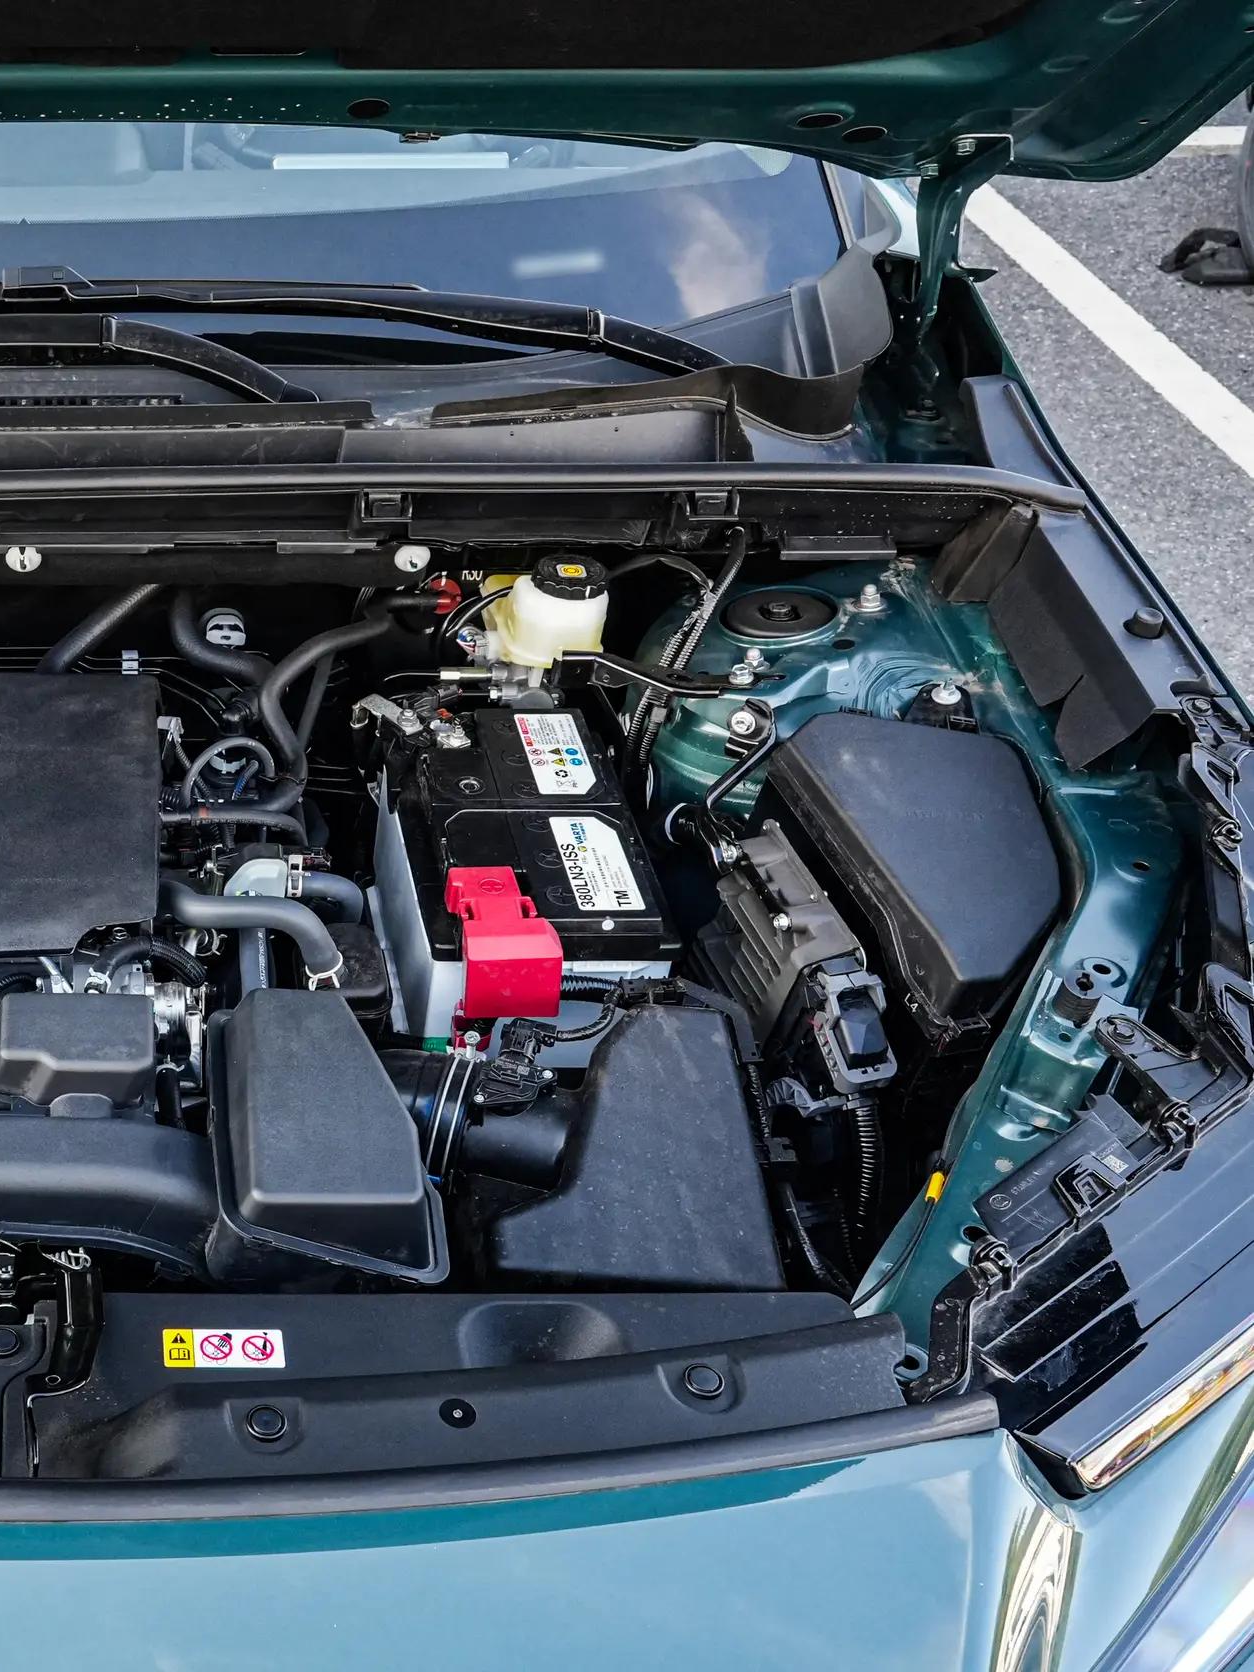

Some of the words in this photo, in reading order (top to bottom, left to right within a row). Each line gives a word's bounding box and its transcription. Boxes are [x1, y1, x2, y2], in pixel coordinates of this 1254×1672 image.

[570, 822, 584, 845] VARTA
[560, 843, 595, 907] 380LN3-ISS
[614, 890, 632, 907] TM
[904, 993, 918, 1013] L4
